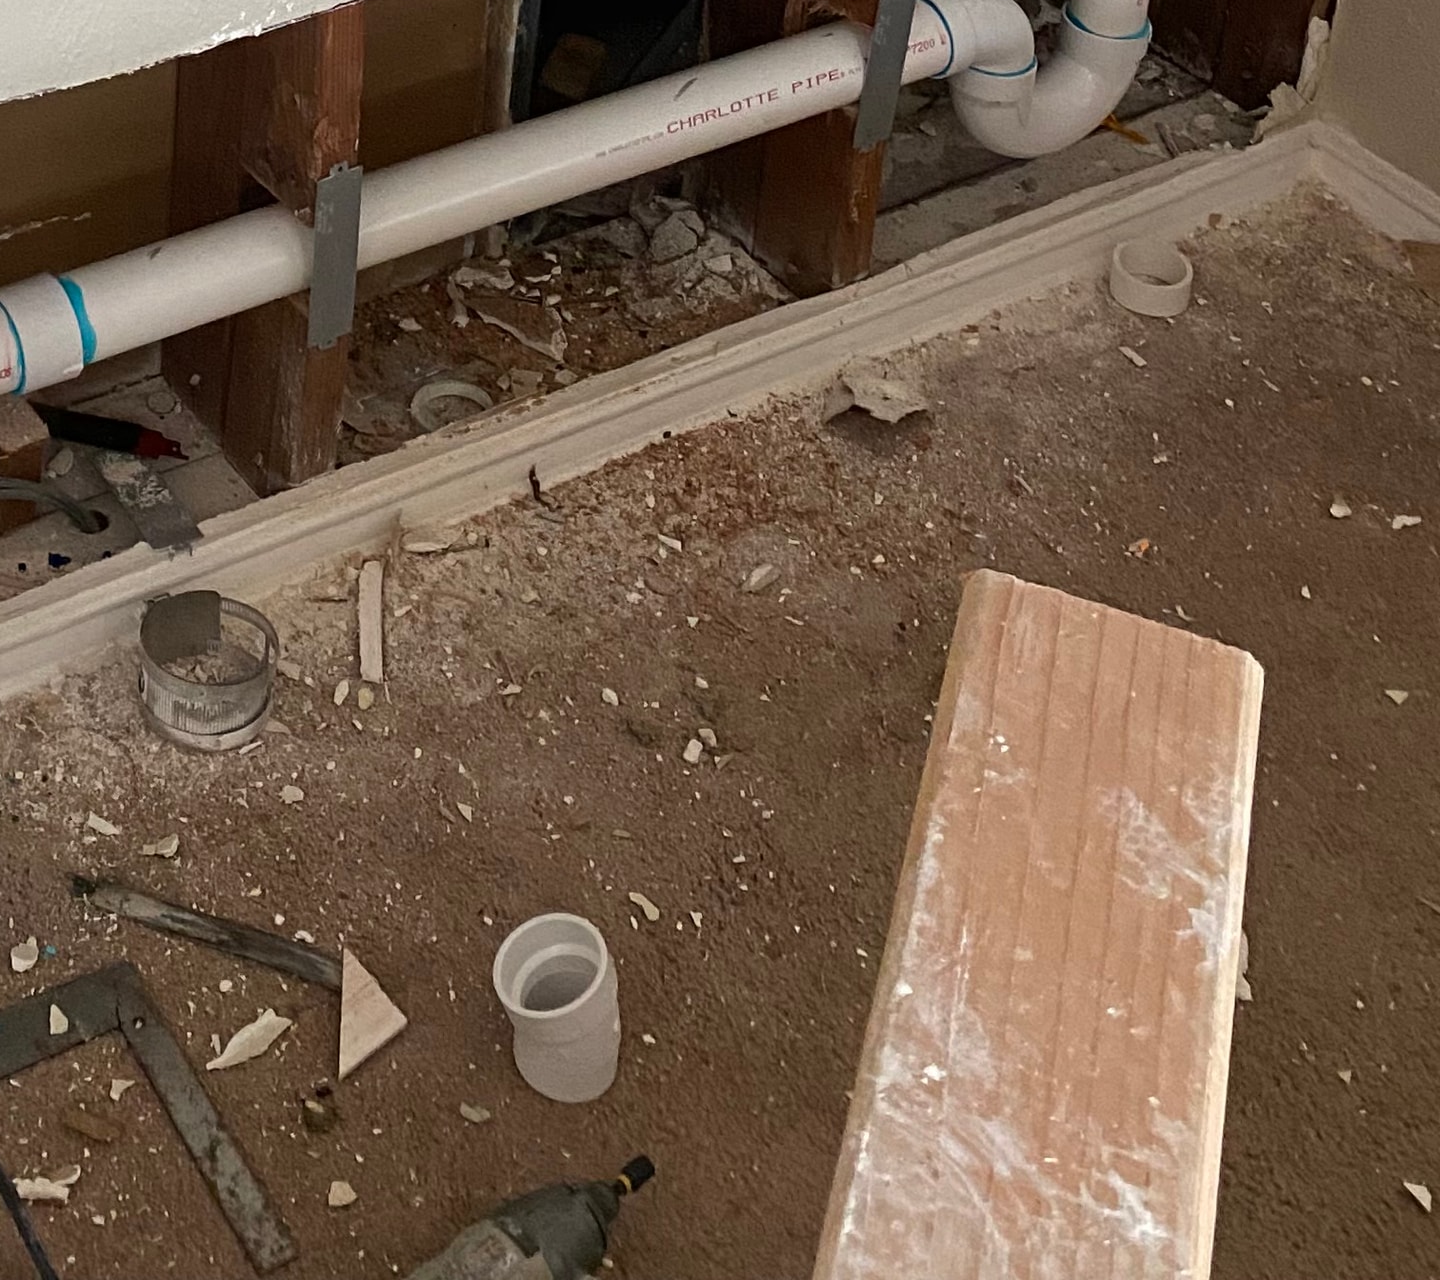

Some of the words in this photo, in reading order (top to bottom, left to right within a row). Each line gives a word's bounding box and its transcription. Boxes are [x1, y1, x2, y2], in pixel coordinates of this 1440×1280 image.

[911, 38, 936, 55] 7200
[667, 88, 779, 134] CHARLOTTE
[791, 68, 839, 93] PIPE
